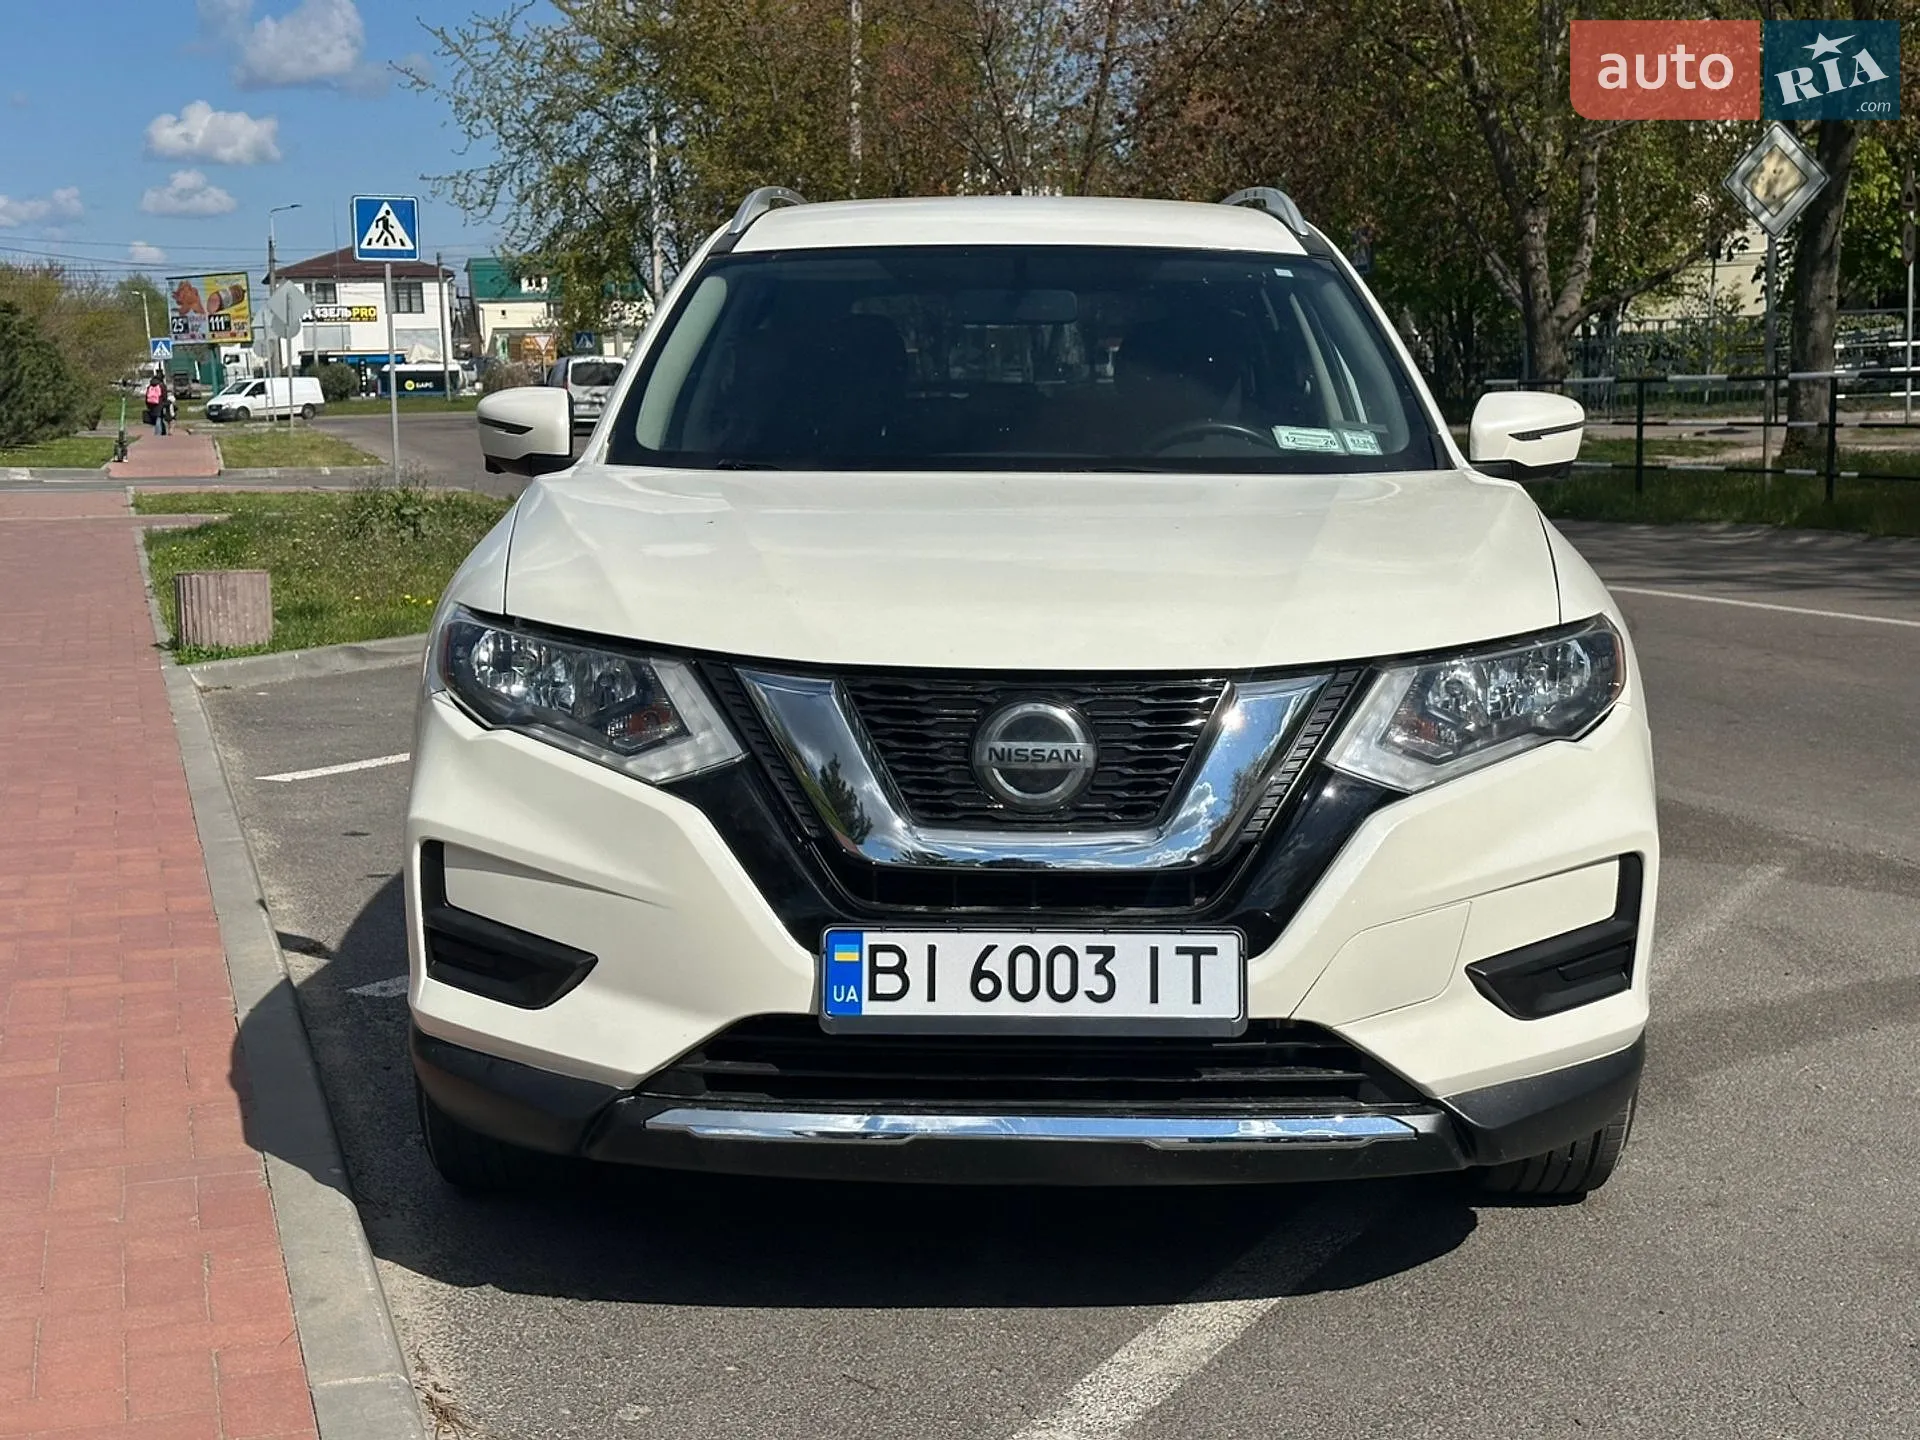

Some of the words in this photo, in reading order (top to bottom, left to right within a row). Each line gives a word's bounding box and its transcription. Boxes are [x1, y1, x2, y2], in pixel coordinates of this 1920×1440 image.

[988, 747, 1081, 763] NISSAN
[868, 944, 937, 1003] BI
[970, 944, 1116, 1003] 6003
[1150, 946, 1218, 1005] IT
[833, 985, 859, 1003] UA
